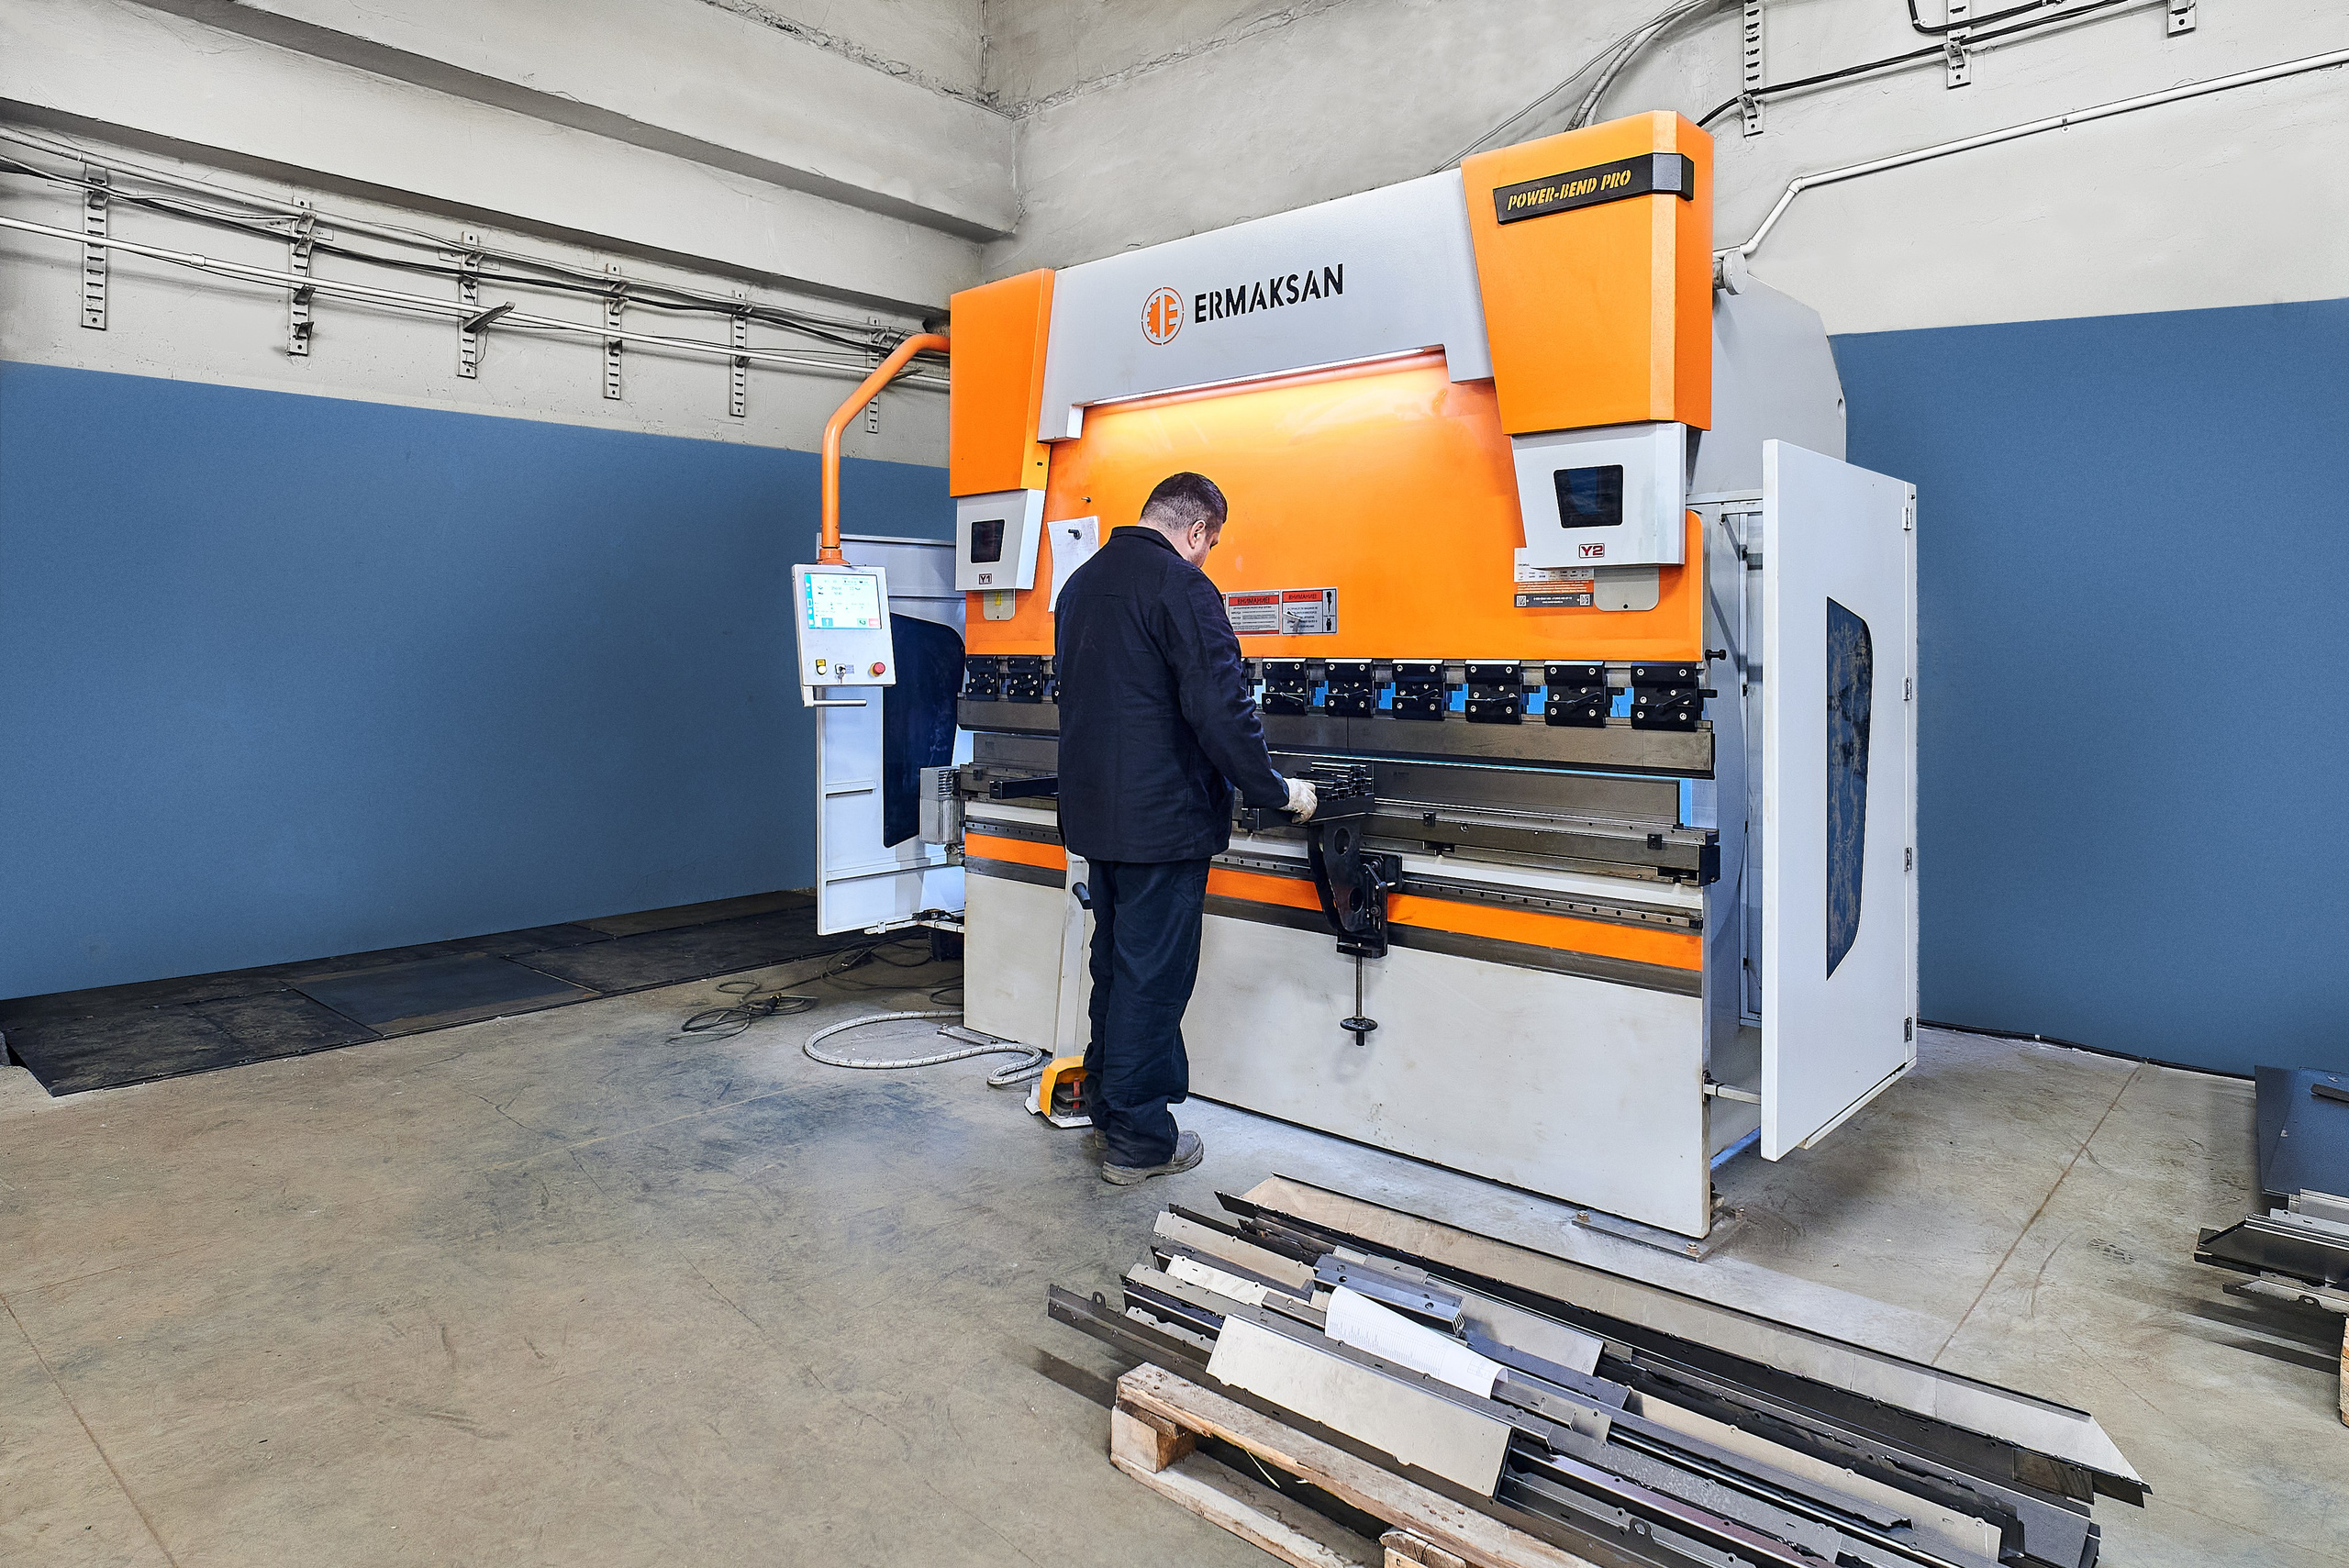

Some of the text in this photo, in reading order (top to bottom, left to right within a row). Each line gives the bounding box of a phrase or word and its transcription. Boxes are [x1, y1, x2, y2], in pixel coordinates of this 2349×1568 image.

[1507, 169, 1631, 211] POWER-BEND PRO
[1195, 262, 1343, 324] ERMAKSAN
[1580, 545, 1604, 557] Y2
[980, 574, 991, 584] Y1
